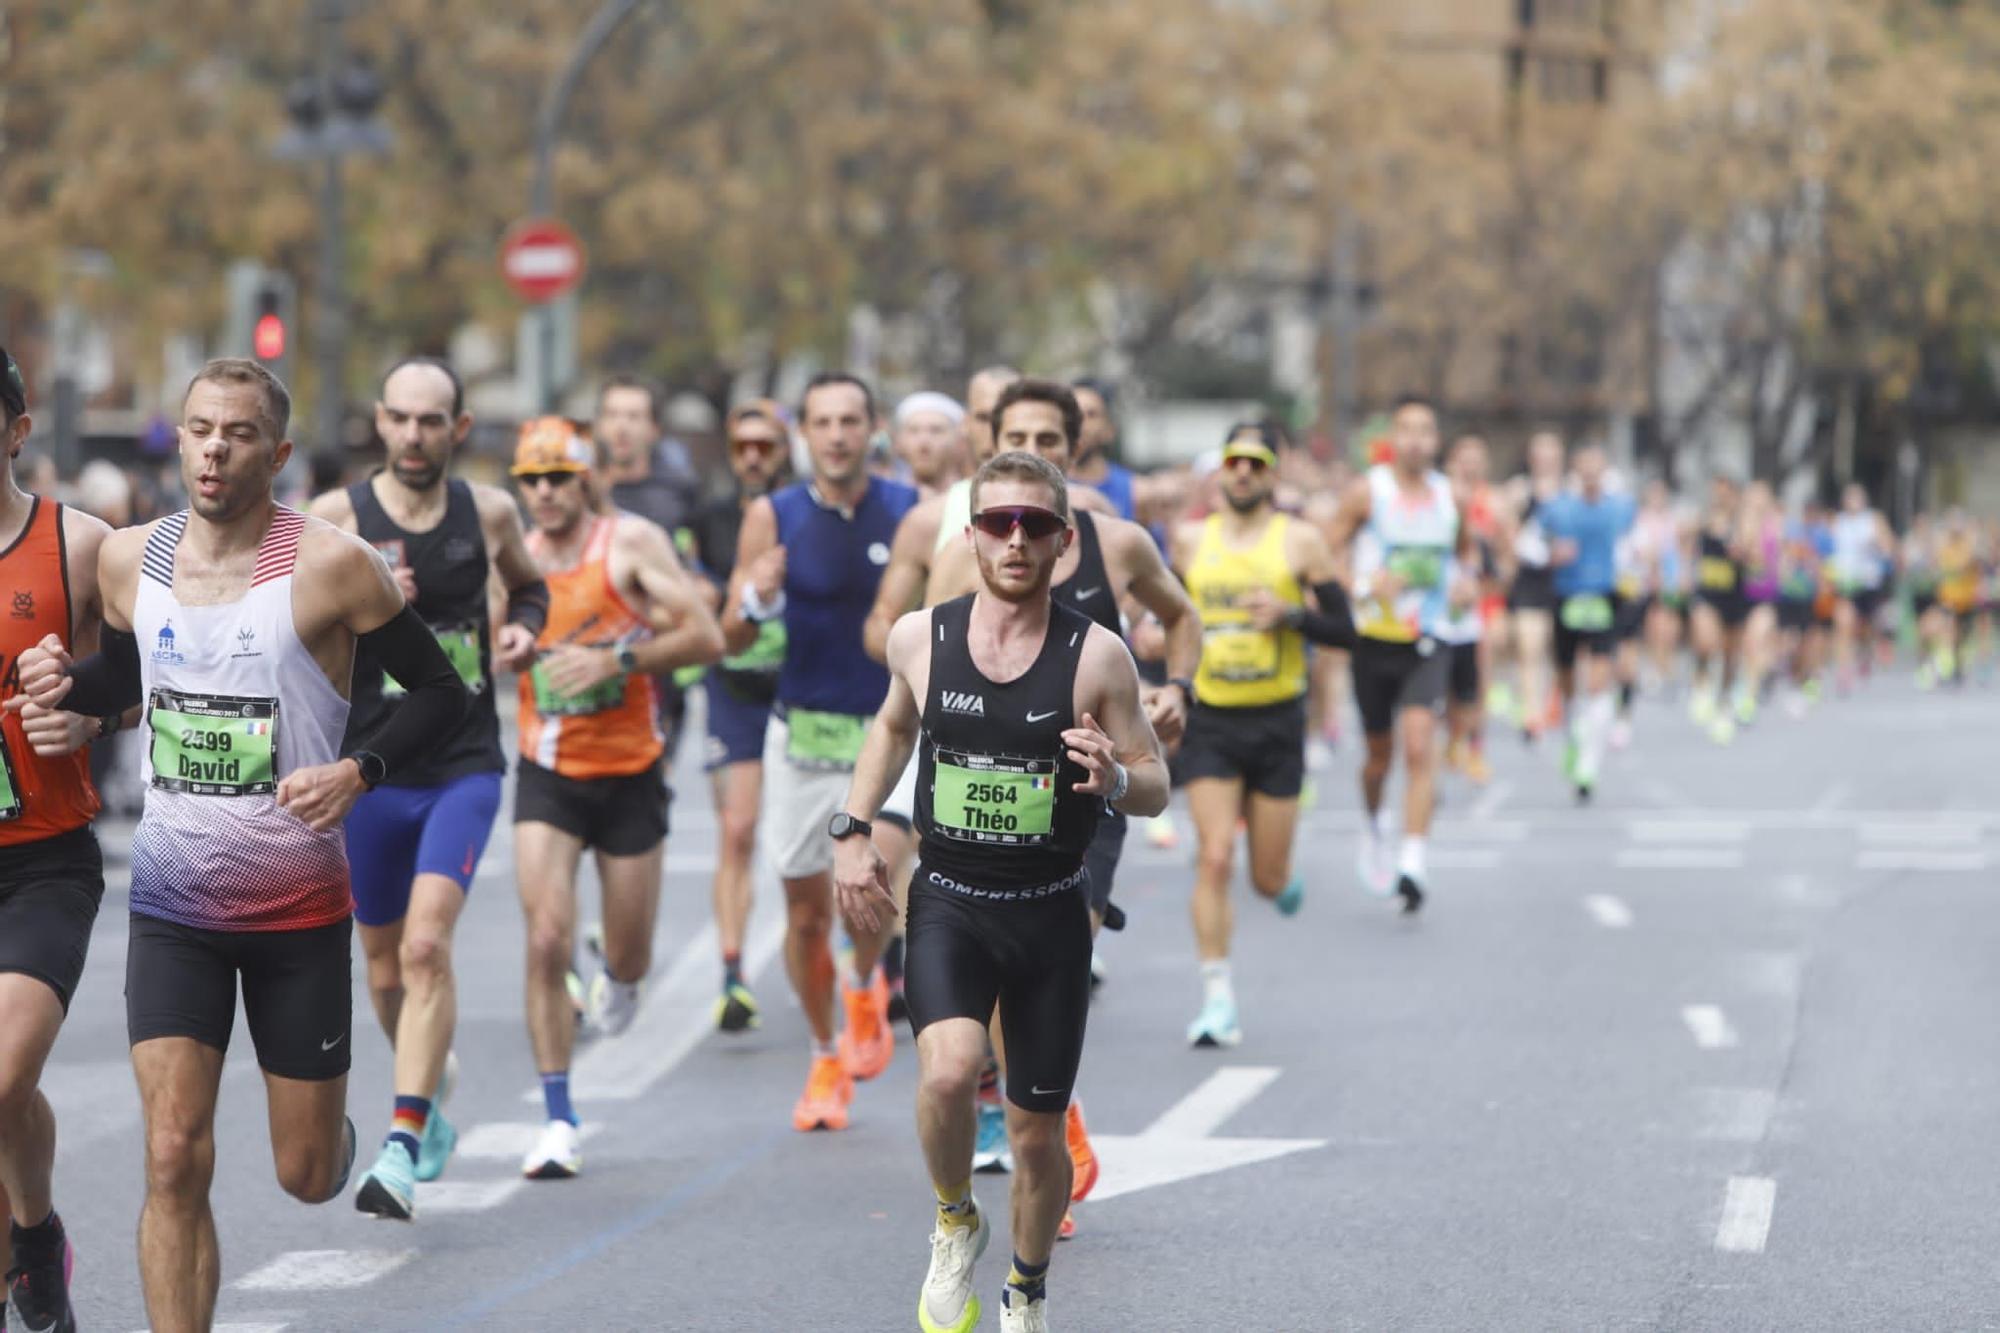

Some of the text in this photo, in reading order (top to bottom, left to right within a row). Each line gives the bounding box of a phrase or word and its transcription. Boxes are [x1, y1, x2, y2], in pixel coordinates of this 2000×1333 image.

[942, 690, 984, 713] VMA
[182, 729, 232, 752] 2599
[178, 753, 240, 781] David
[966, 783, 1018, 804] 2564
[963, 806, 1018, 831] Théo
